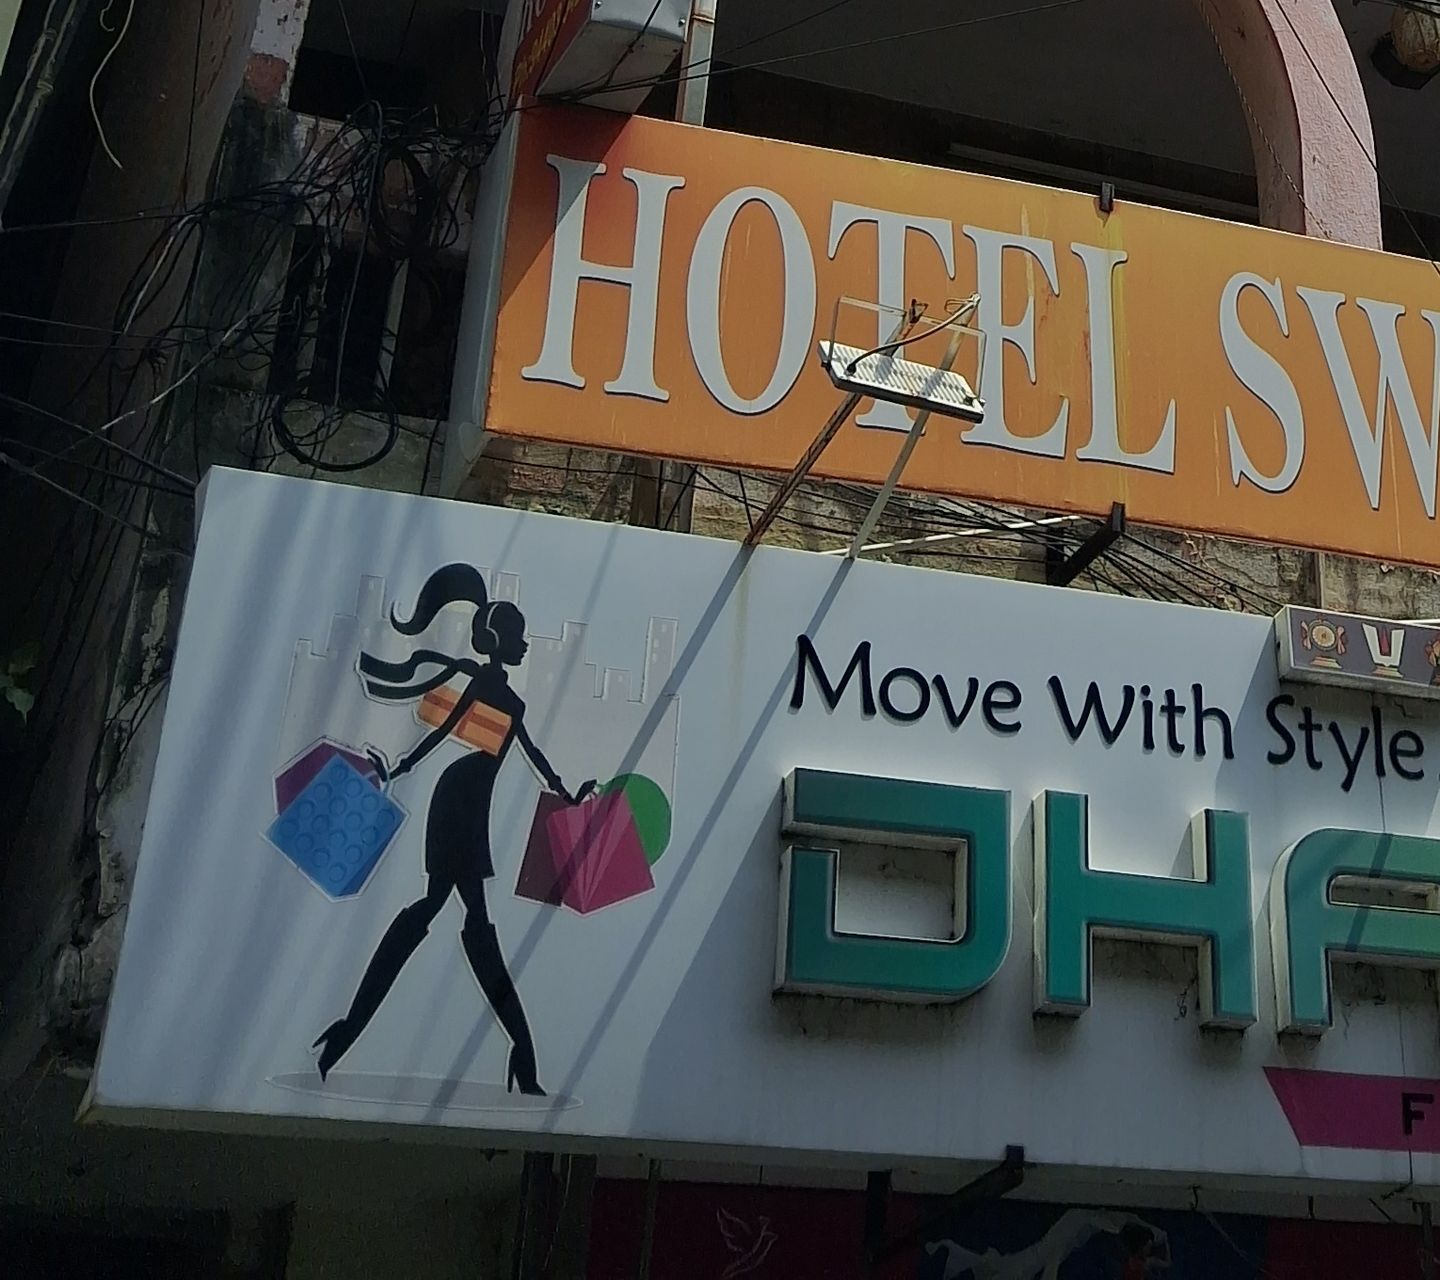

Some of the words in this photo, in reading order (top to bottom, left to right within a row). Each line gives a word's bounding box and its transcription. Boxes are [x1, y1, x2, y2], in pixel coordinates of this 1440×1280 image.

[521, 153, 1176, 474] HOTEL
[790, 634, 1023, 734] Move
[1047, 675, 1234, 760] With
